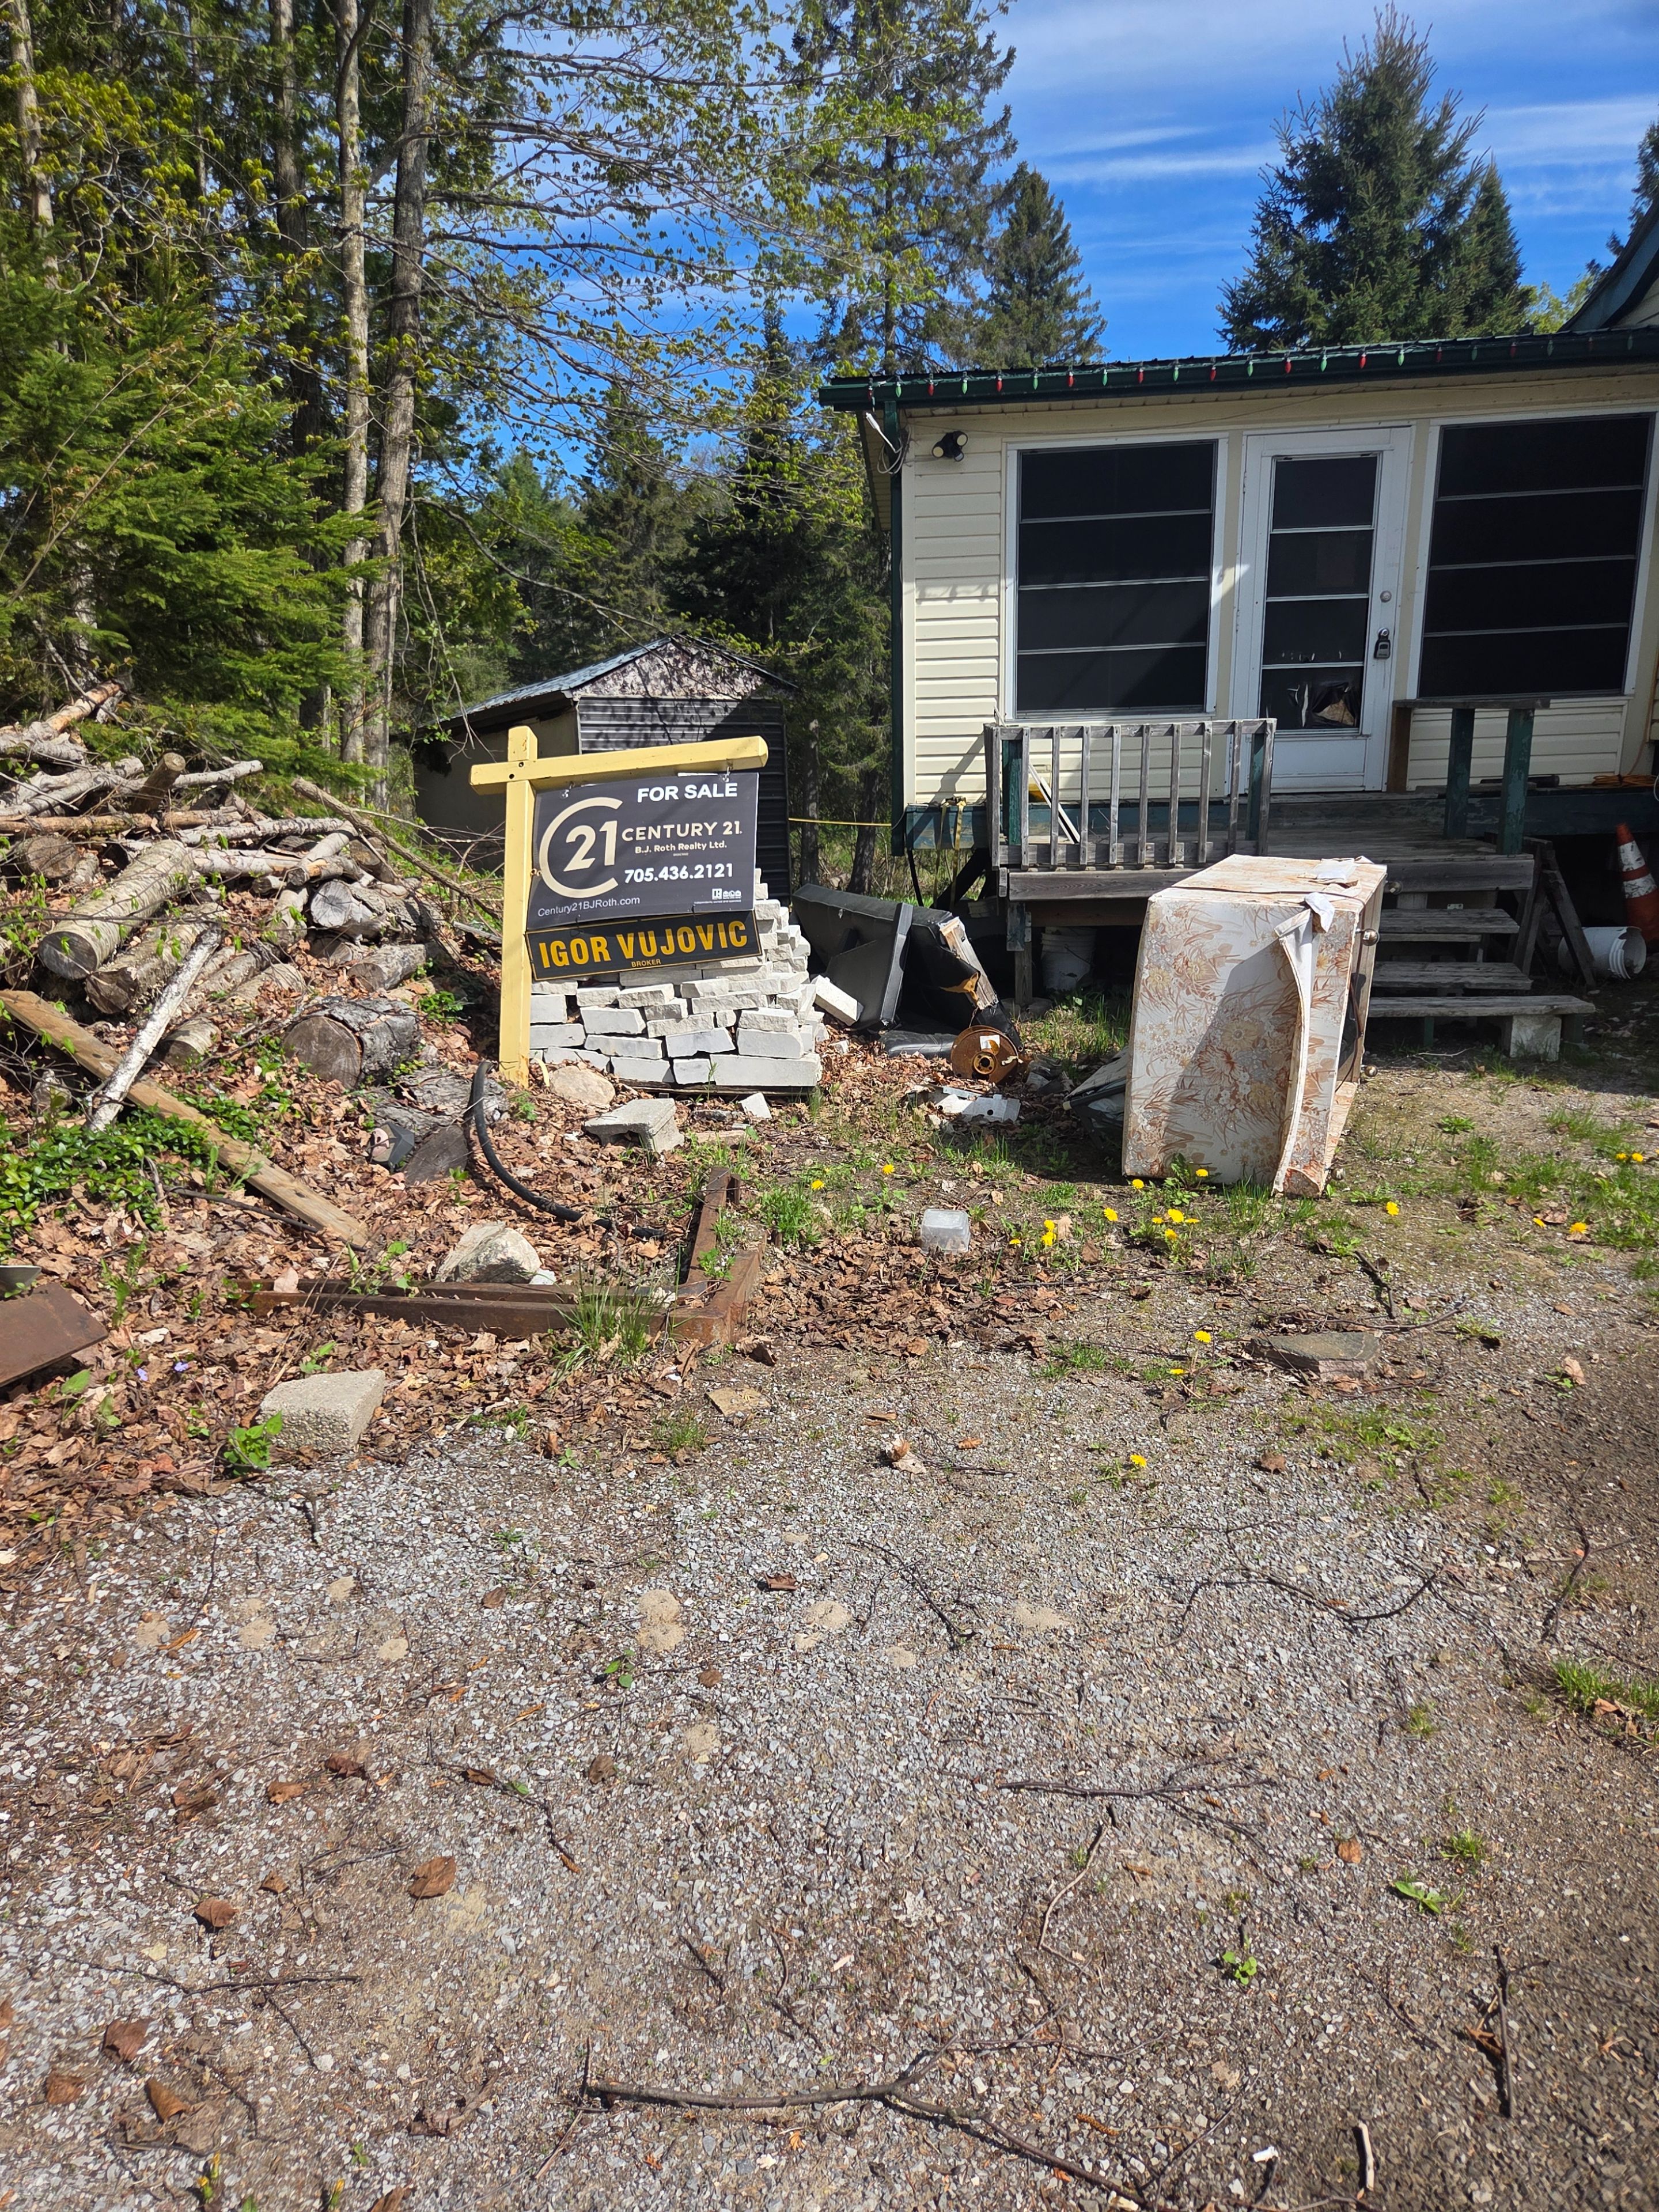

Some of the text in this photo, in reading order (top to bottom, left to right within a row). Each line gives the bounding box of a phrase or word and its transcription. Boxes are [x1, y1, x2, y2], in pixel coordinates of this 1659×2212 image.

[637, 782, 738, 803] FOR SALE
[622, 822, 718, 841] CENTURY
[635, 840, 727, 854] B.J. Roth Realty Ltd.
[624, 863, 733, 884] 705.436.2121
[538, 897, 641, 917] Century21BJRoth.com
[539, 921, 748, 968] IGOR VUJOVIC
[631, 959, 661, 967] BROKER
